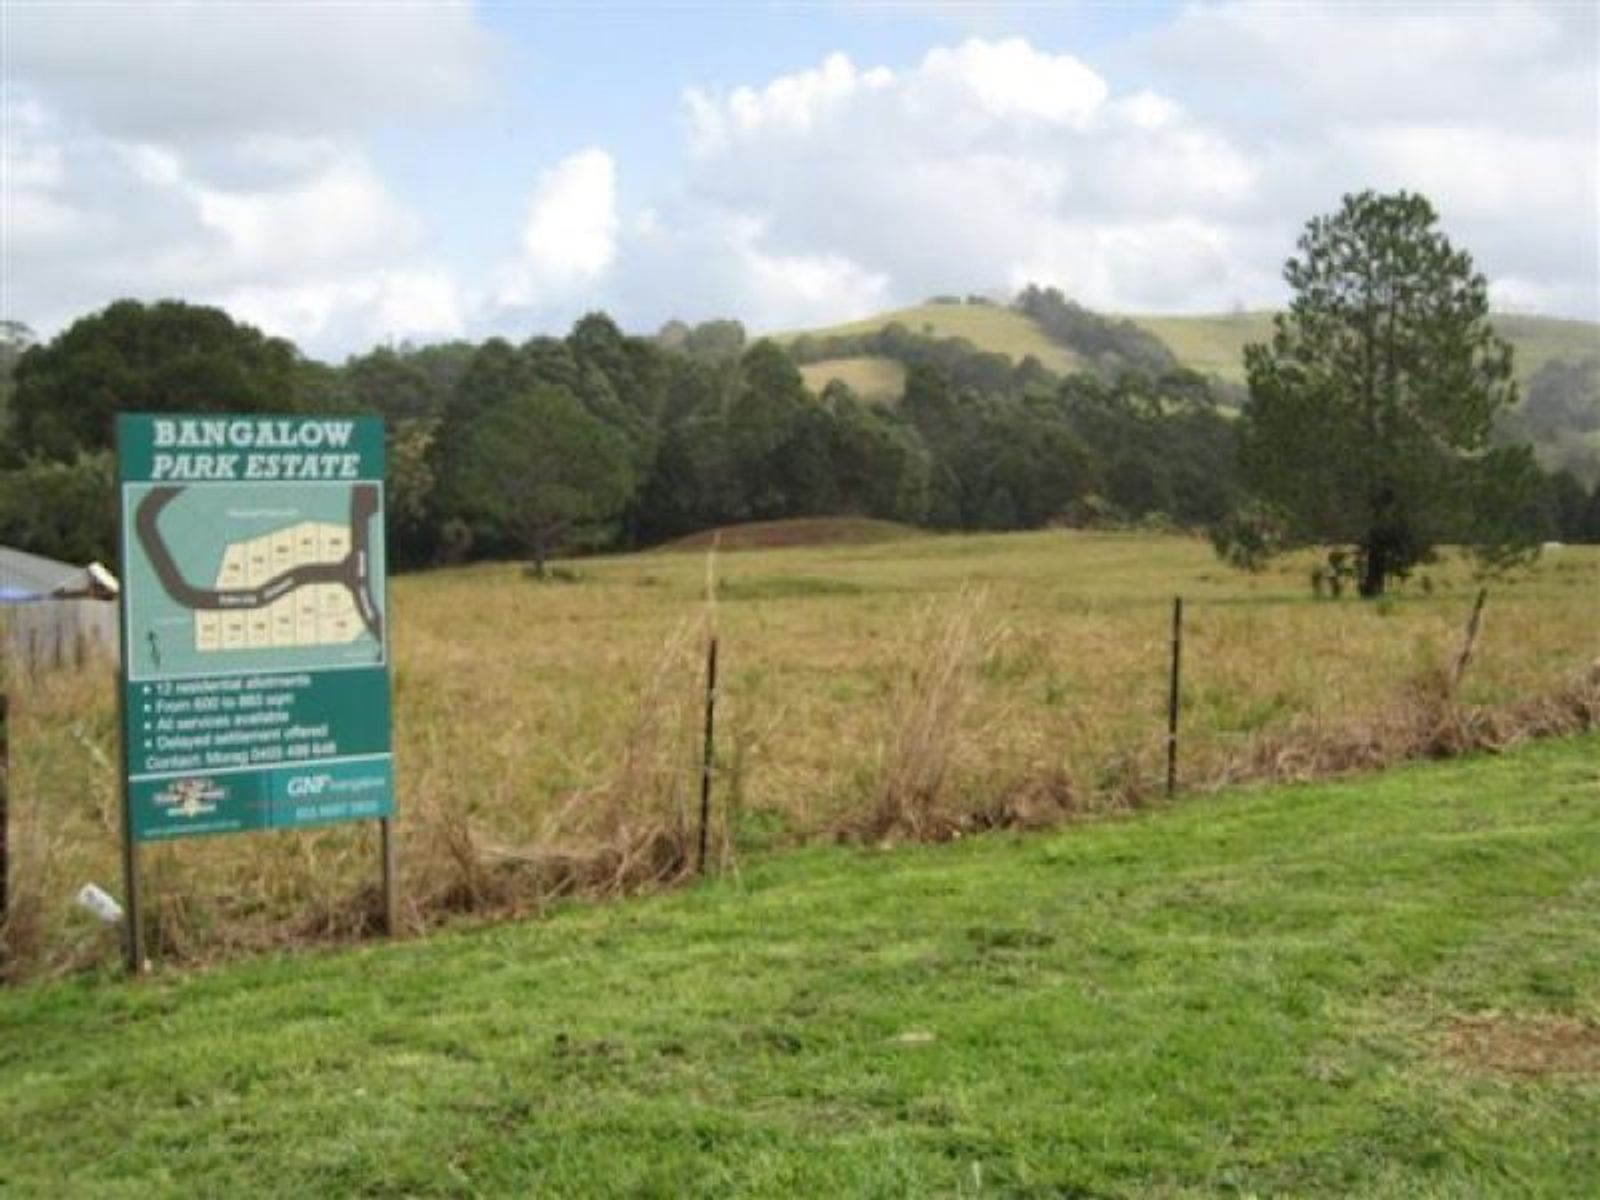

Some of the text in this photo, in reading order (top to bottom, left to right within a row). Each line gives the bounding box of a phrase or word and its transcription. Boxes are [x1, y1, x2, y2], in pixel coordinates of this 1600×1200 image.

[153, 418, 354, 448] BANGALOW
[151, 453, 361, 480] PARK ESTATE
[176, 679, 242, 694] residential
[156, 698, 191, 712] From
[221, 696, 236, 709] to
[176, 714, 231, 729] services
[234, 711, 289, 726] available
[157, 723, 329, 750] Delayed settlement offered
